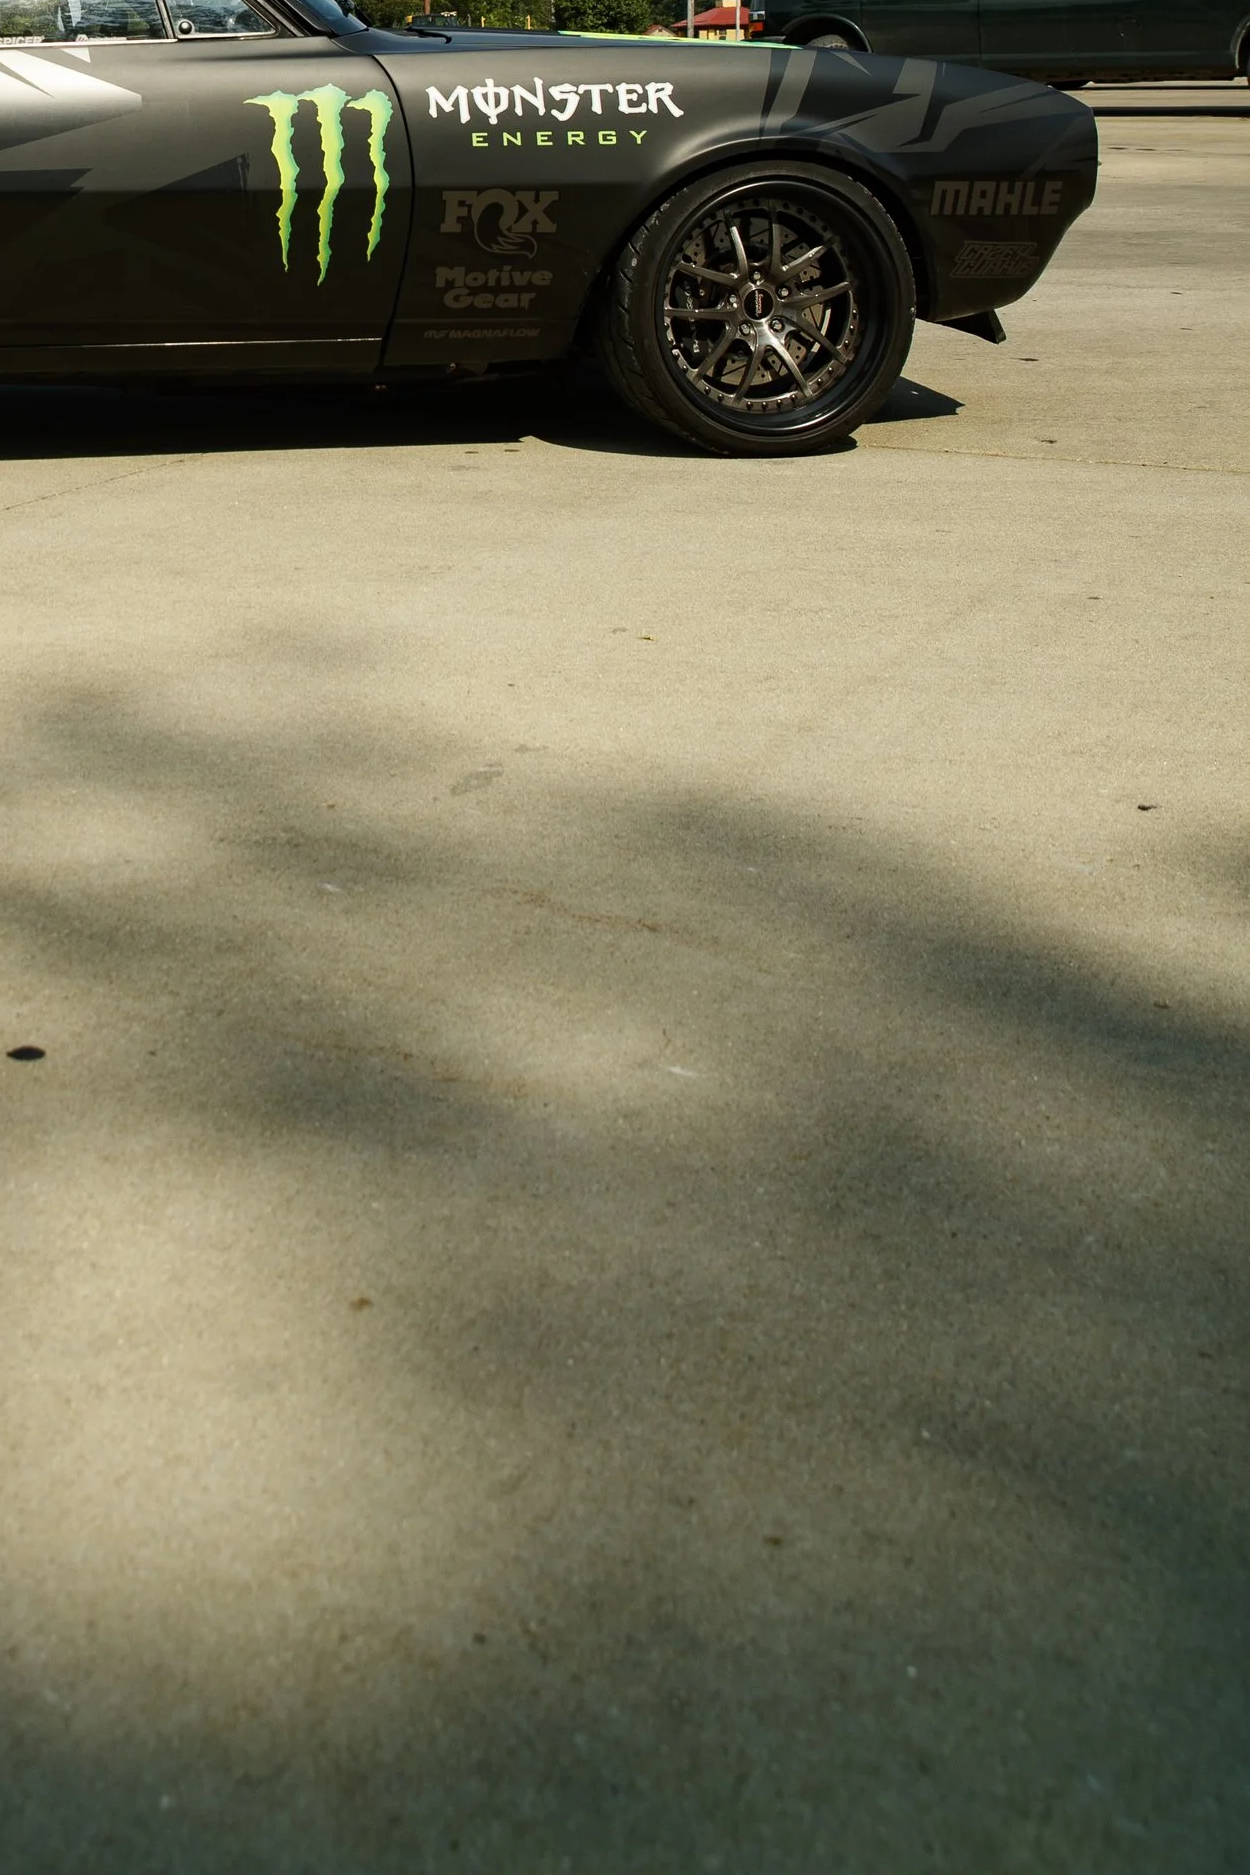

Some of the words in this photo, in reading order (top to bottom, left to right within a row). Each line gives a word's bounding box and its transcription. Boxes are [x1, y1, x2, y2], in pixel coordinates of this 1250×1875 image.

[425, 76, 684, 125] MONSTER
[471, 130, 647, 147] ENERGY
[930, 180, 1063, 215] MAHLE
[440, 188, 559, 258] FOX
[435, 265, 553, 288] Motive
[443, 287, 536, 310] Gear
[449, 328, 541, 339] MAGNAFLOW
